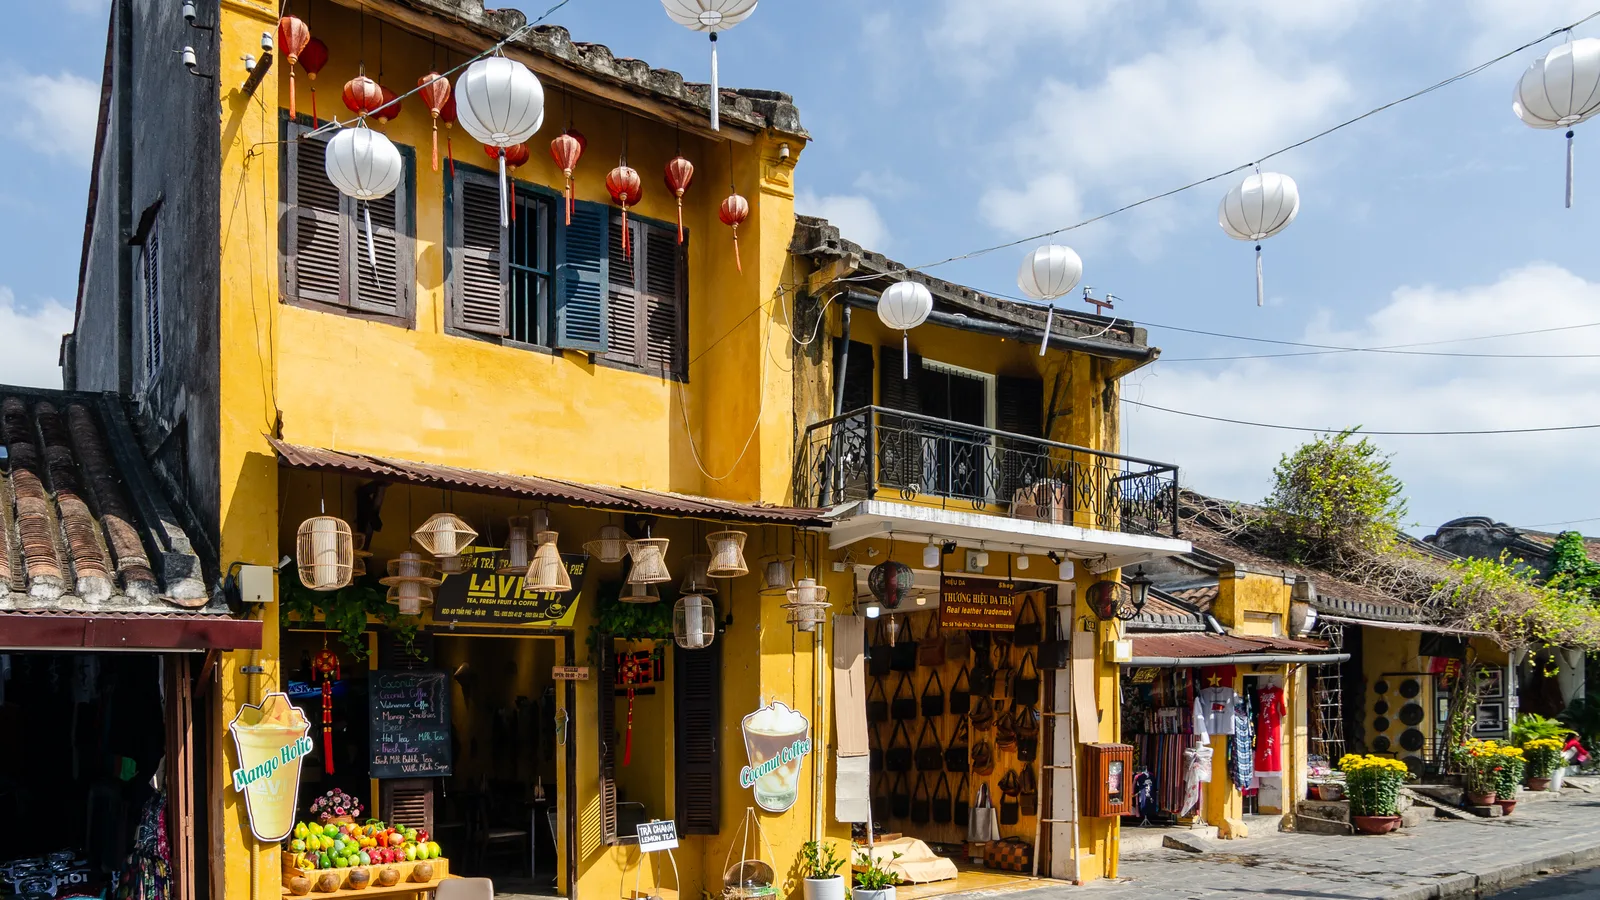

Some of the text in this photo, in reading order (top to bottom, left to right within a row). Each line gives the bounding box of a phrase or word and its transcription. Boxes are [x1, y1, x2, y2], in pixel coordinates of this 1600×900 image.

[570, 563, 584, 575] PHÊ
[466, 597, 479, 605] TEA,
[944, 592, 1016, 606] THƯƠNG HIỆU DA THẬT
[961, 606, 982, 615] leather
[379, 675, 415, 689] Coconut
[380, 688, 428, 702] Coconut Coffee
[413, 700, 430, 710] Coffee
[382, 711, 405, 724] Mango
[382, 721, 404, 732] Beer
[381, 733, 410, 743] Hot Tea
[418, 731, 445, 741] Milk Tea
[382, 743, 420, 754] Fresh Juice
[234, 737, 312, 790] Mango Holic
[421, 753, 433, 763] Tea
[742, 739, 810, 785] Coconut Coffee
[652, 823, 674, 834] CHANH
[641, 832, 675, 843] LEMON TEA
